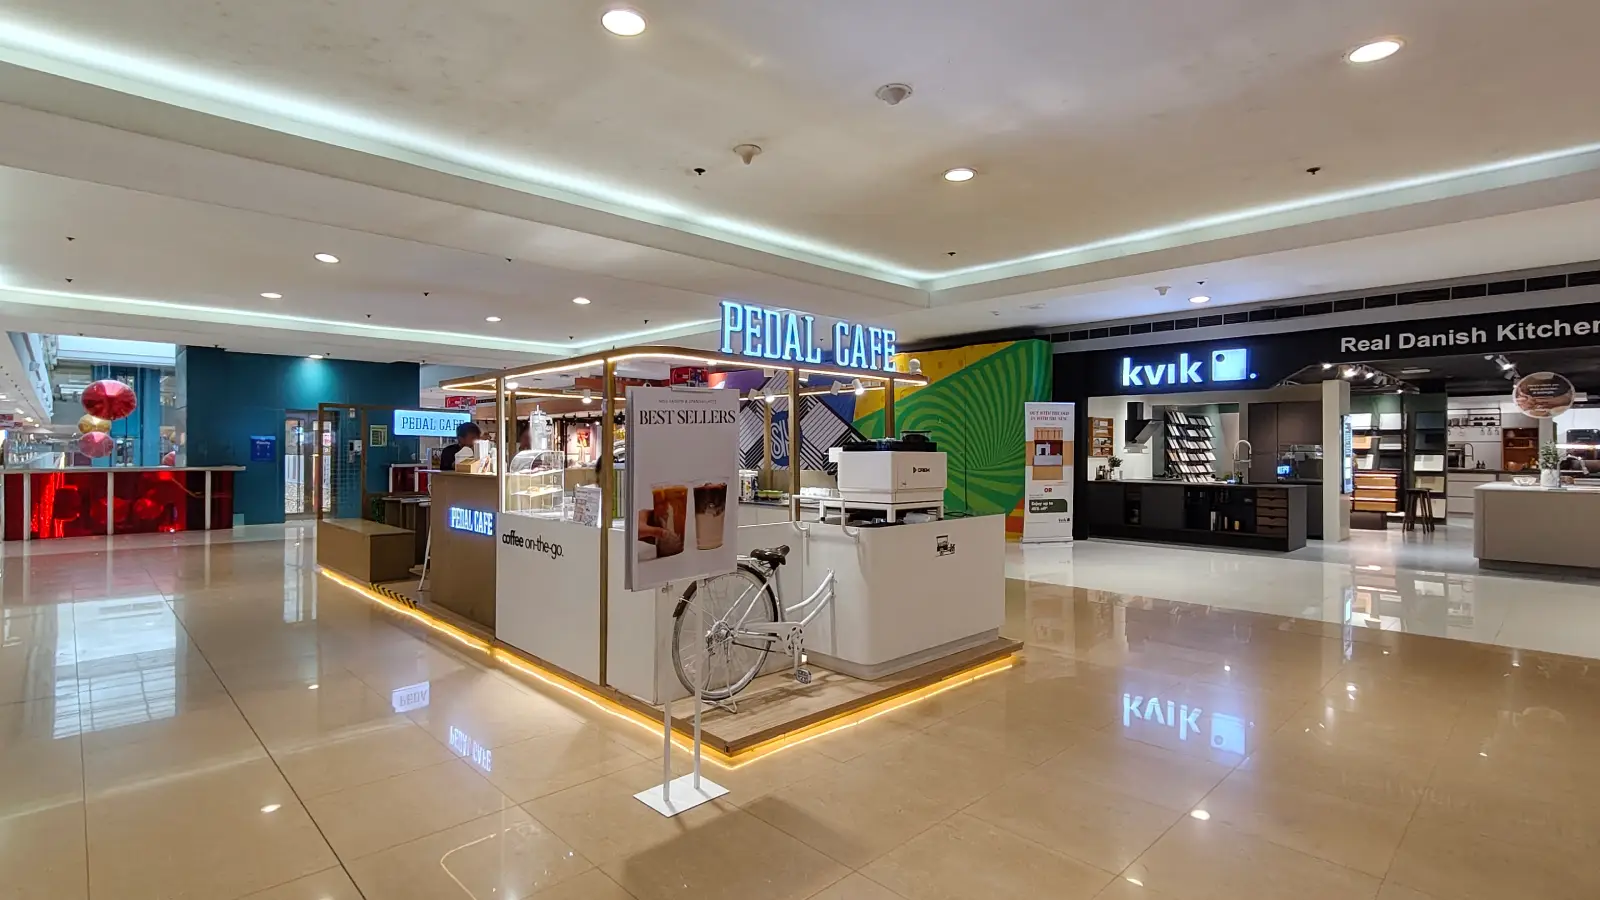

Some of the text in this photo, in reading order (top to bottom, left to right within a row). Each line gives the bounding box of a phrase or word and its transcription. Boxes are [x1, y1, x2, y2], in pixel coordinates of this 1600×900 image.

[720, 301, 897, 373] PEDAL CAFE
[1340, 334, 1390, 353] Real
[1398, 327, 1487, 349] Danish
[1122, 353, 1203, 387] kvik
[402, 416, 436, 431] PEDAL
[640, 409, 736, 425] BEST SELLERS
[450, 507, 493, 536] PEDAL CAFE
[502, 530, 564, 560] coffee on-the-go.
